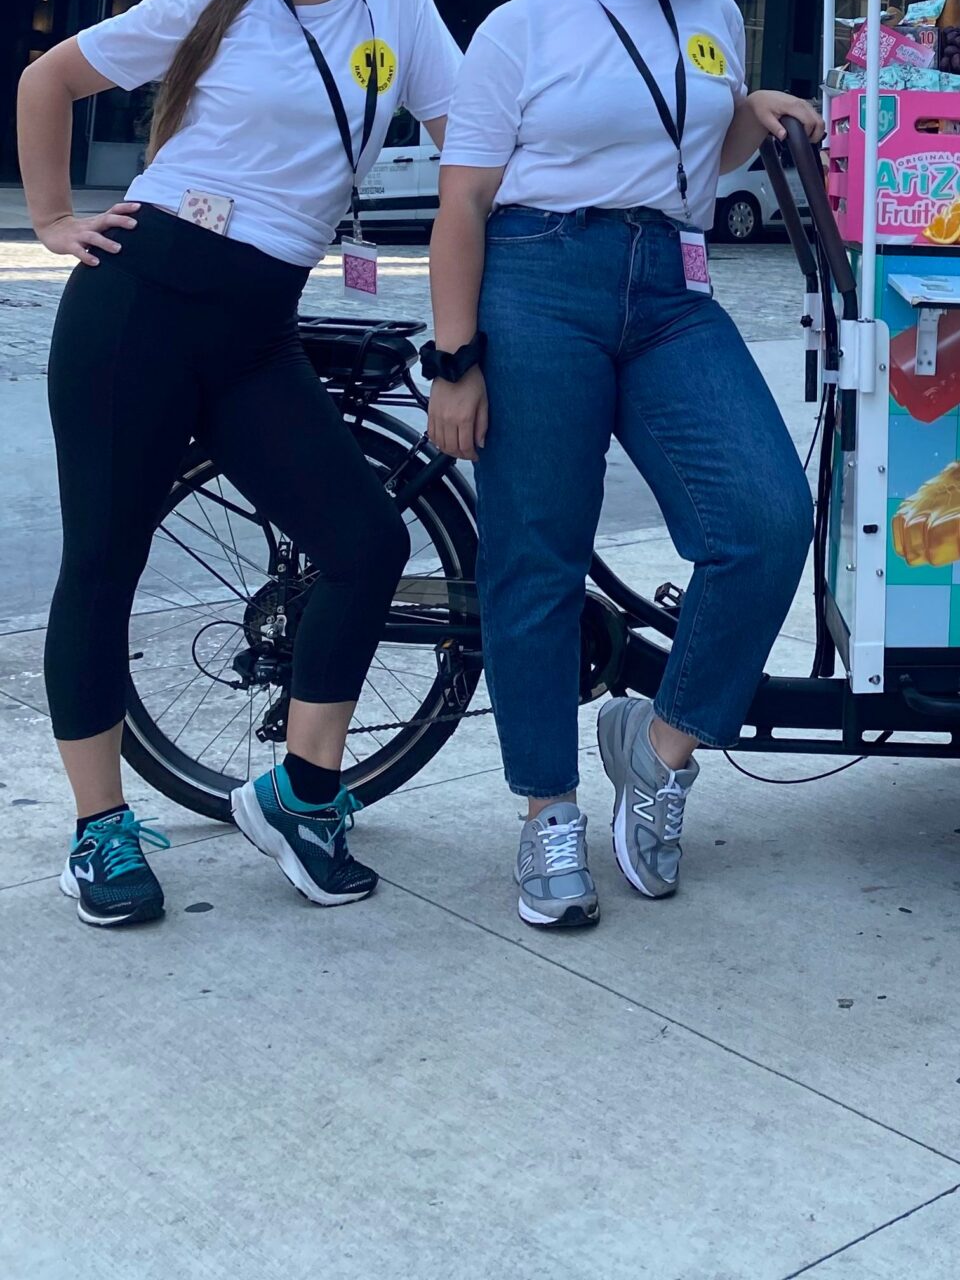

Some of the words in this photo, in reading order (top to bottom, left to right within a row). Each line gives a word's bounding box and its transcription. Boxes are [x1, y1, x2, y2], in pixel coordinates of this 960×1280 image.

[920, 31, 935, 44] 10
[897, 153, 950, 167] ORIGINAL
[881, 200, 932, 226] Fruit
